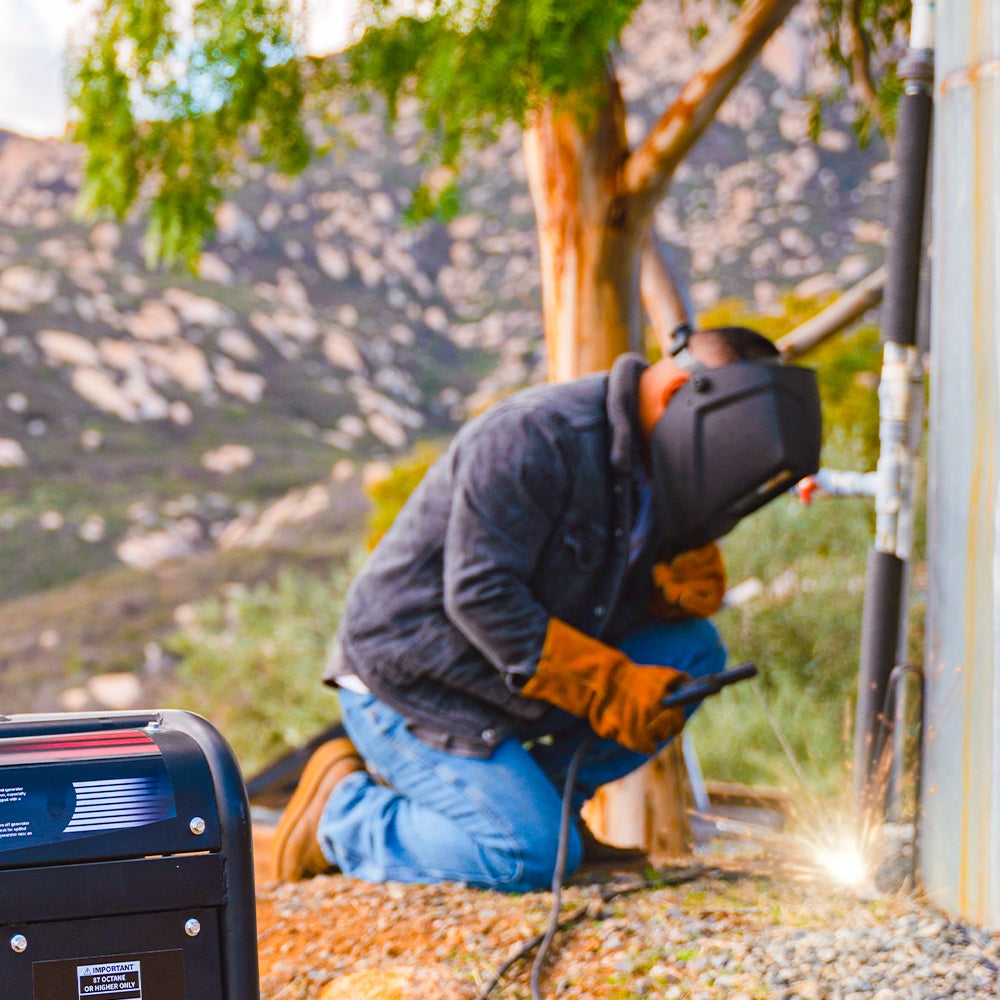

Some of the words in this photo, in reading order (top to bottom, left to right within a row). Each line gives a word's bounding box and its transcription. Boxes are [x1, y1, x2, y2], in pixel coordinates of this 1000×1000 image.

[92, 964, 134, 974] IMPORTANT
[101, 974, 126, 983] OCTANE
[94, 983, 119, 992] HIGHER
[119, 981, 136, 990] ONLY
